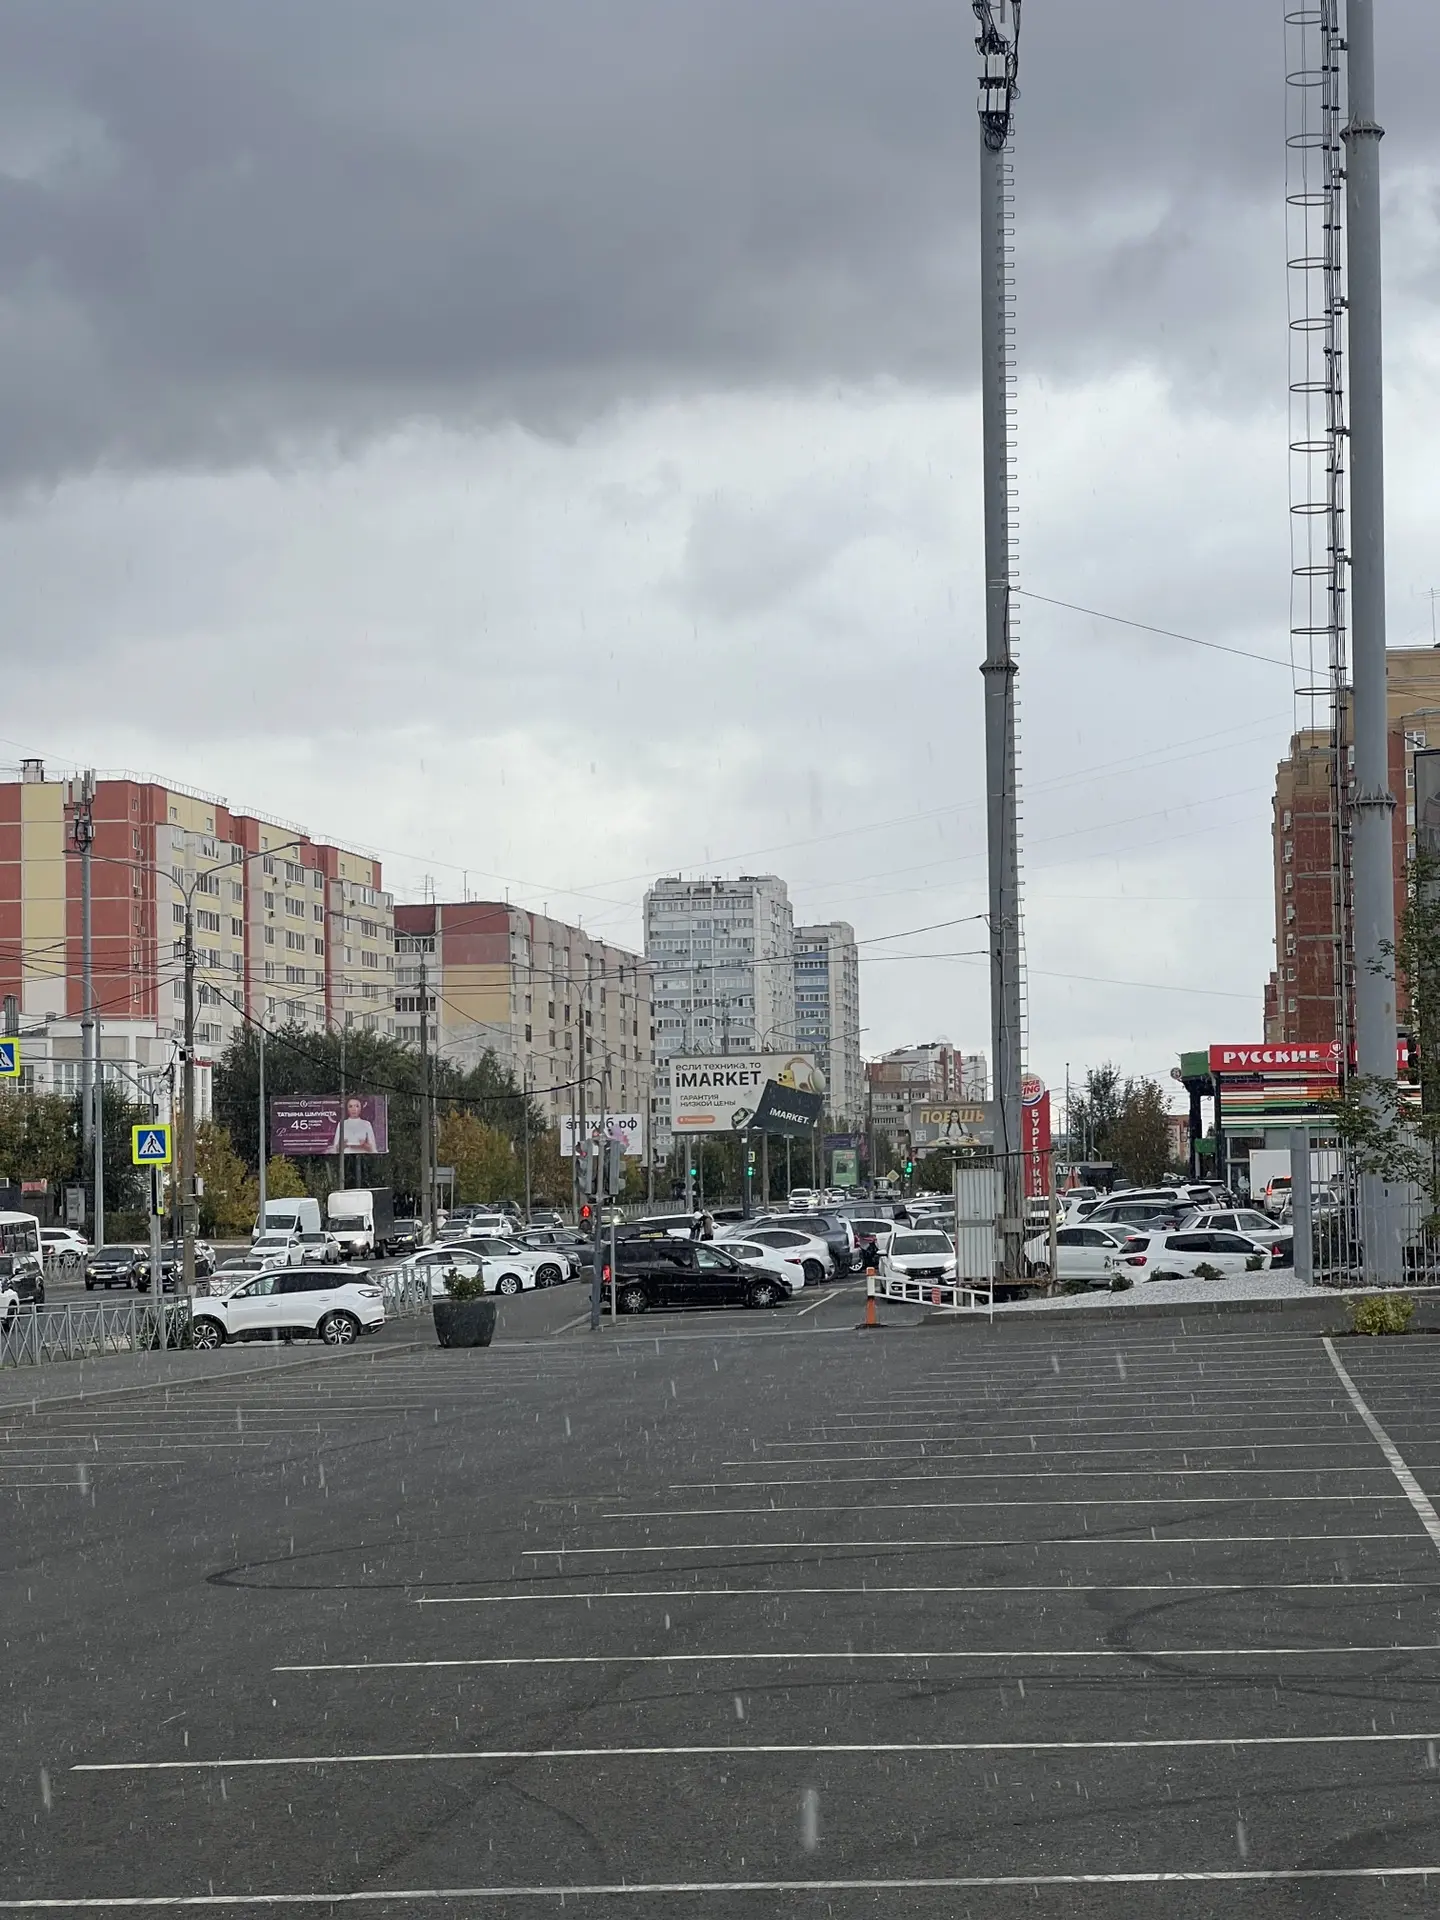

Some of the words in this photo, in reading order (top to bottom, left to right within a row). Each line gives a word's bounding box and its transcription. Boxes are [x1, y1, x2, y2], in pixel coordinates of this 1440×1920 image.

[704, 1062, 747, 1070] техника,
[1222, 1049, 1320, 1066] РУССКИЕ
[1031, 1109, 1040, 1164] БУРГЕР
